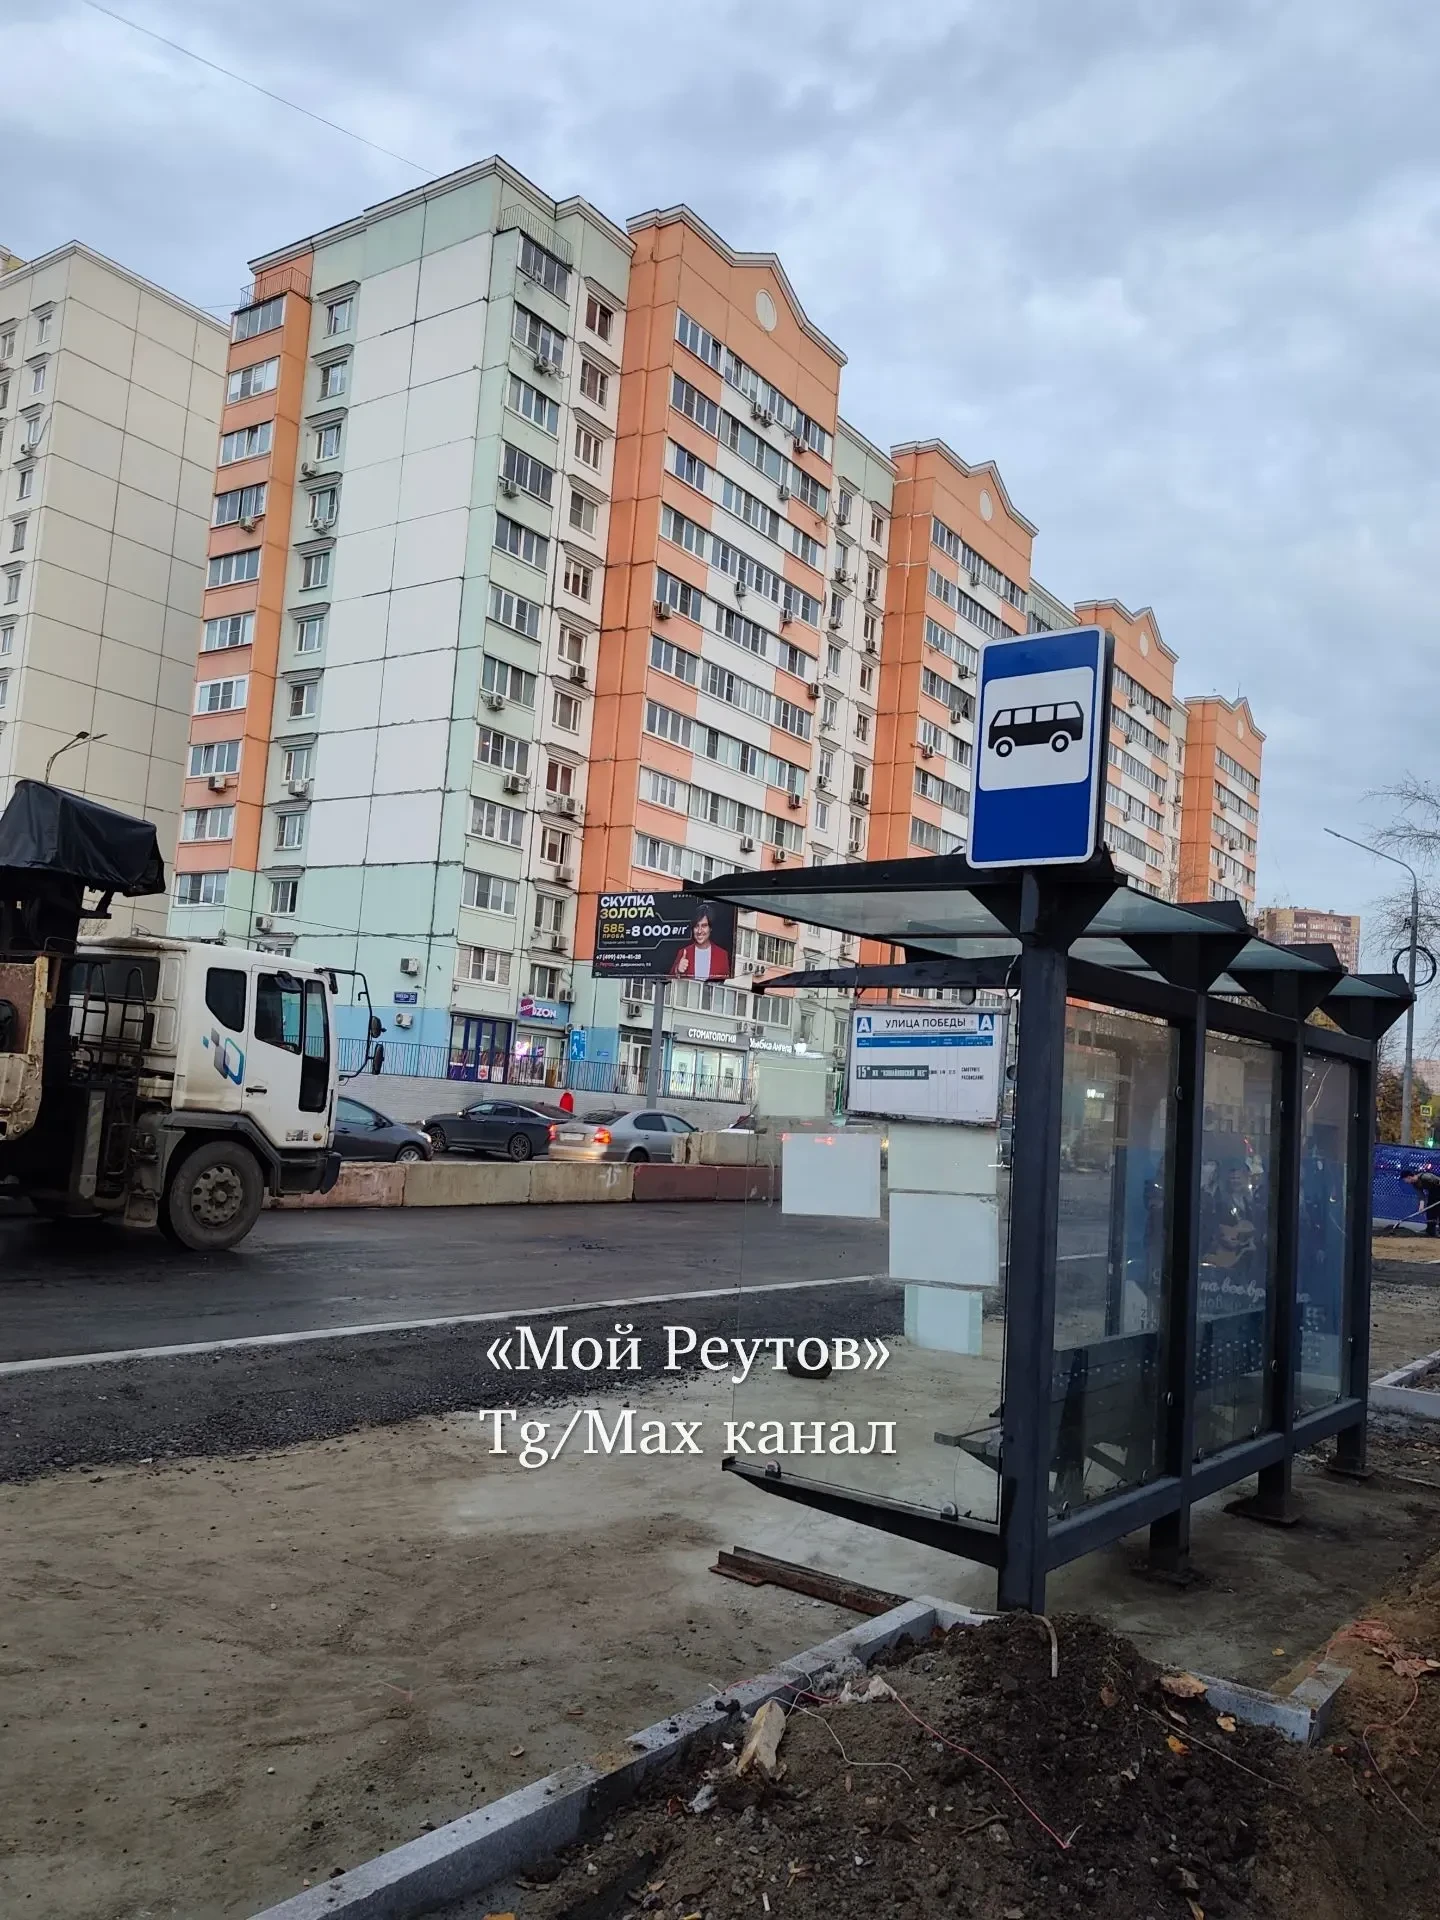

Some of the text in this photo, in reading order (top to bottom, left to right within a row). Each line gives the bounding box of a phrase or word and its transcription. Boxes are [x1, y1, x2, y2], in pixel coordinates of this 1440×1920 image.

[600, 895, 655, 907] СКУПКА
[600, 907, 655, 919] ЗОЛОТА
[603, 923, 625, 933] 585
[885, 1019, 920, 1029] УЛИЦА
[922, 1018, 966, 1028] ПОБЕДЫ
[688, 1028, 737, 1043] СТОМАТОЛОГИЯ
[772, 1041, 793, 1053] Ангела
